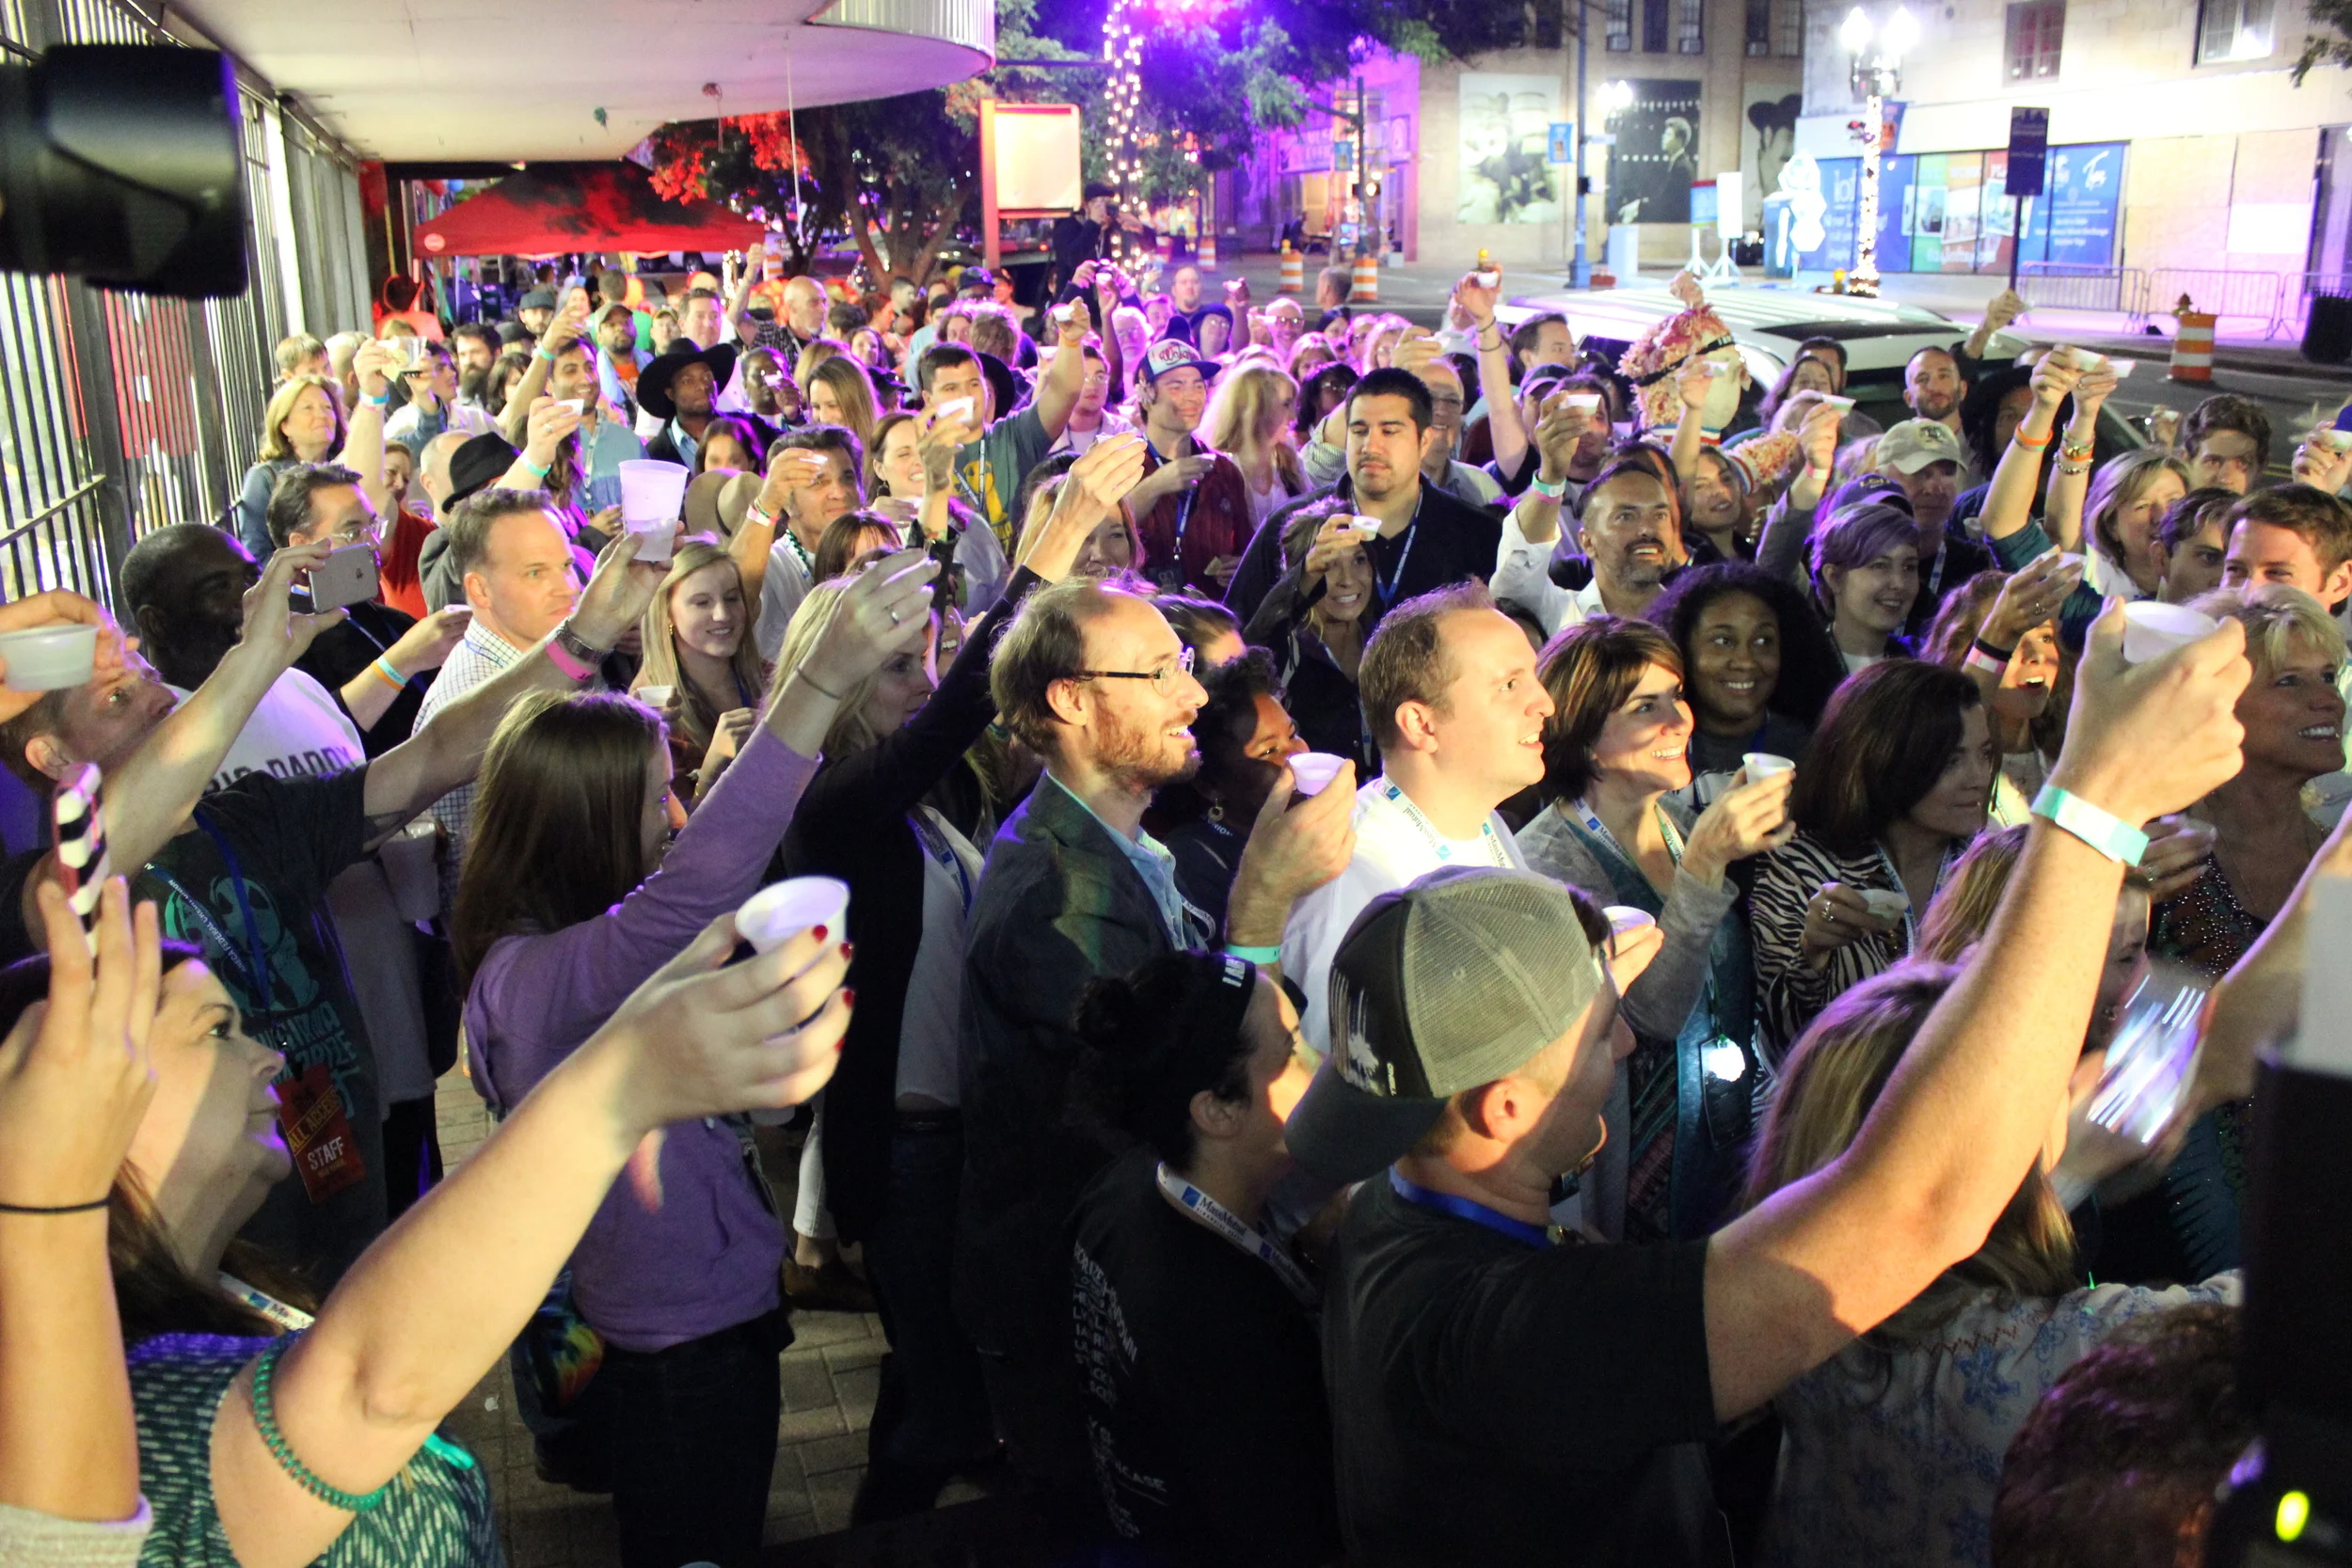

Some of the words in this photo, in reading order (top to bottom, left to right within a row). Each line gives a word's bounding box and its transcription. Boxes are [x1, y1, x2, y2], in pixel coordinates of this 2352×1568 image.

[203, 920, 232, 952] FEDERAL
[307, 1135, 344, 1171] STAFF
[1197, 1196, 1249, 1236] MassMutual
